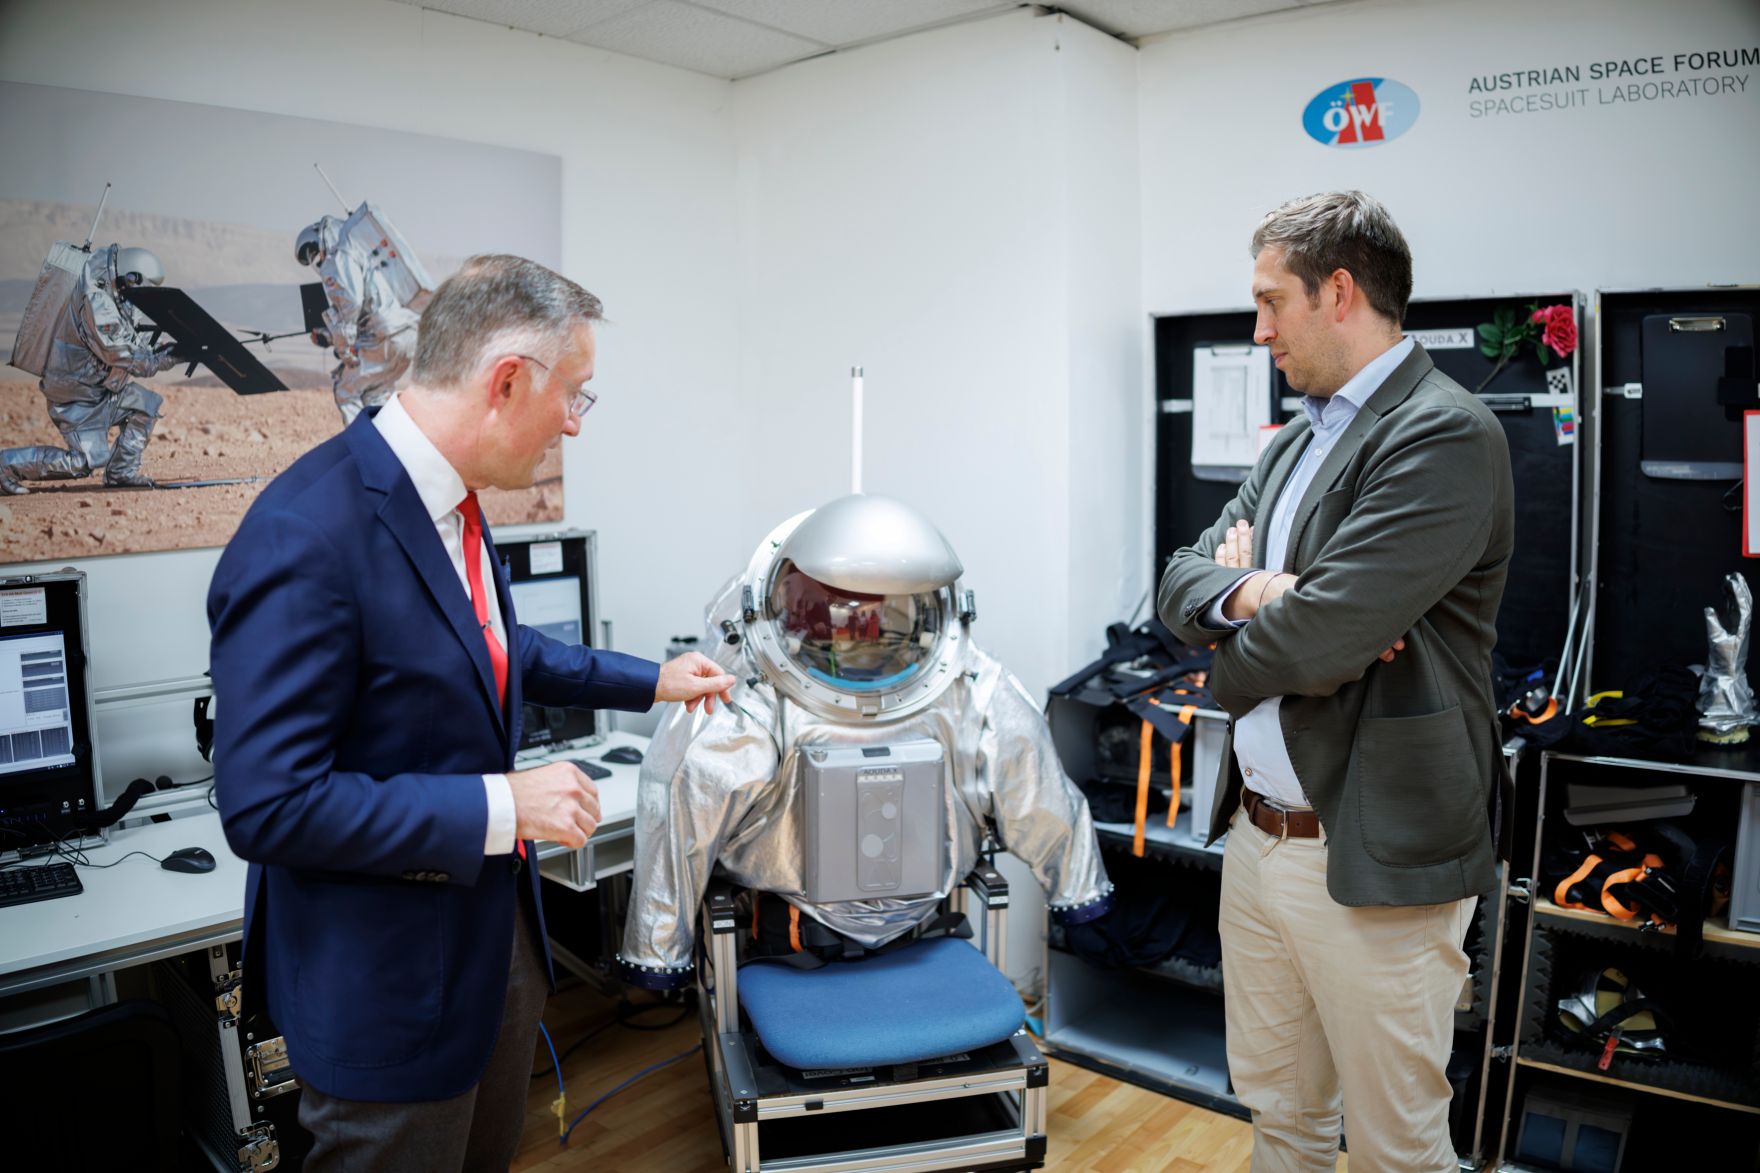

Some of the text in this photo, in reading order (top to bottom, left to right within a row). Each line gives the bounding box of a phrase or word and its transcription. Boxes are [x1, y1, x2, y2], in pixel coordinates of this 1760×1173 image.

[1468, 47, 1760, 94] AUSTRIAN SPACE FORUM
[1469, 74, 1750, 118] SPACESUIT LABORATORY
[1323, 100, 1394, 133] ÖWF
[1458, 332, 1469, 344] X
